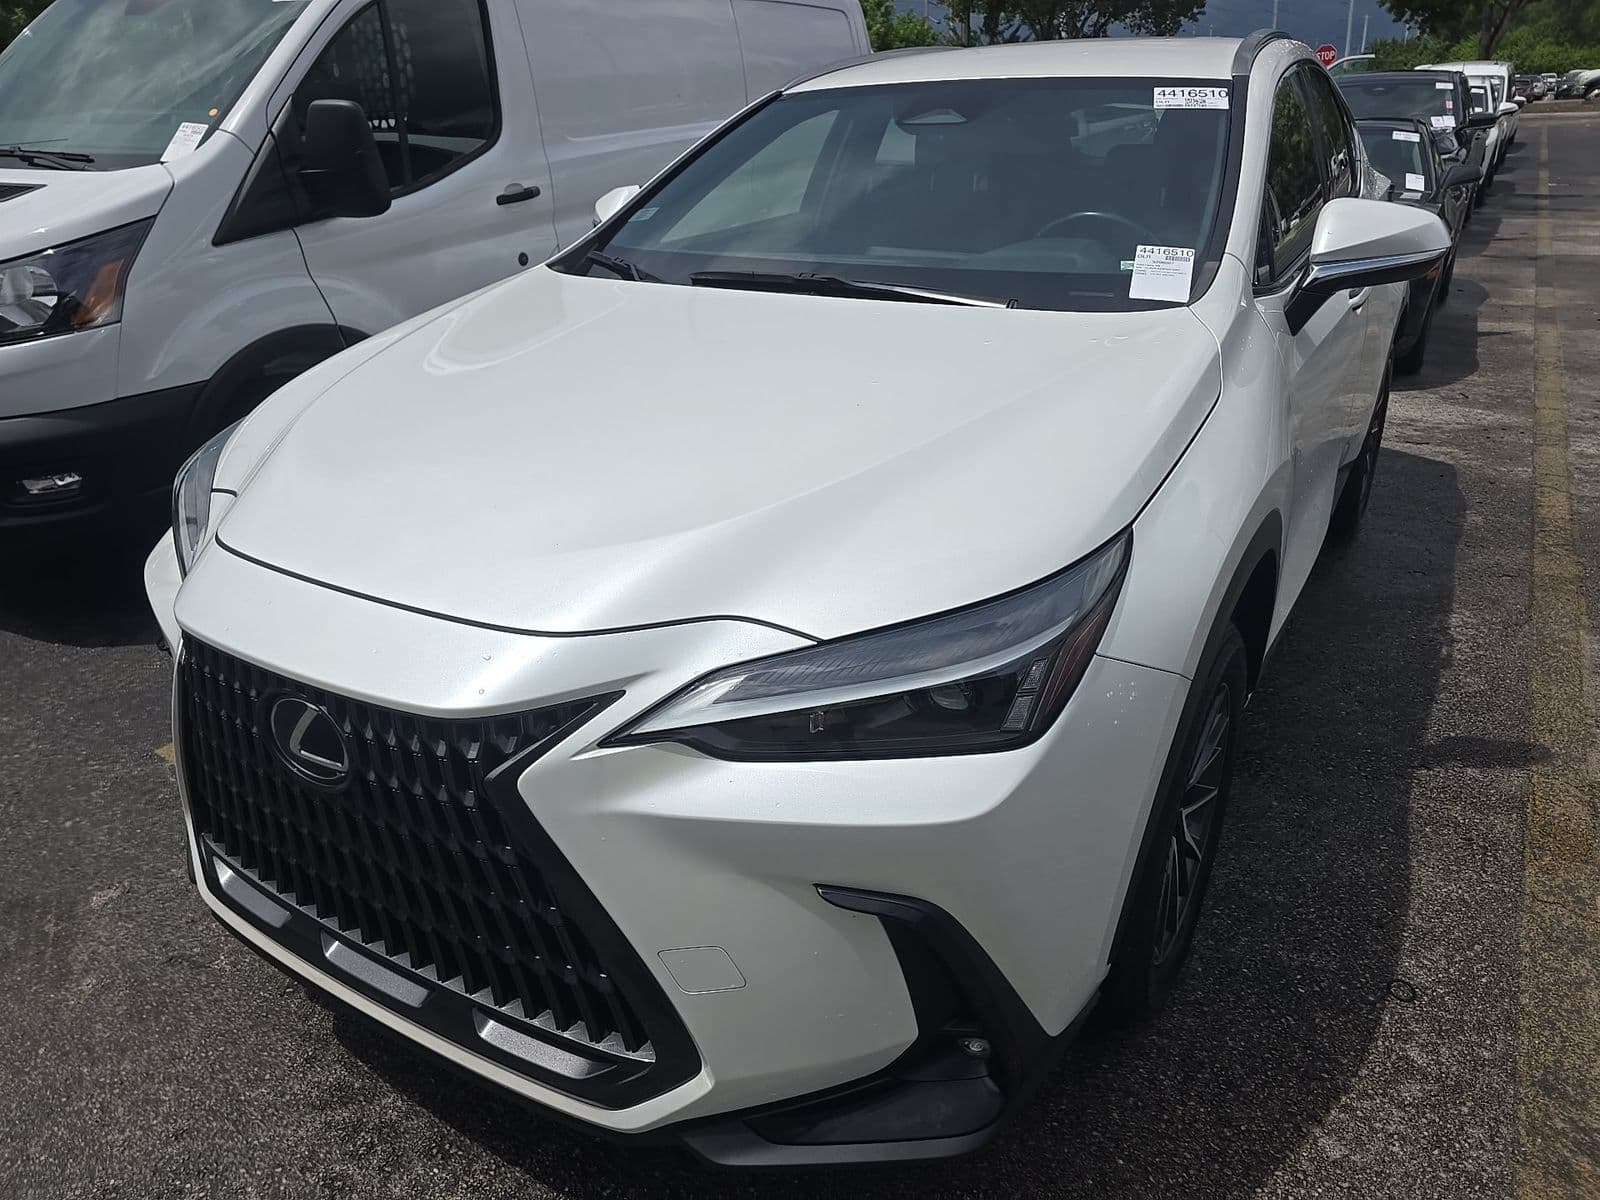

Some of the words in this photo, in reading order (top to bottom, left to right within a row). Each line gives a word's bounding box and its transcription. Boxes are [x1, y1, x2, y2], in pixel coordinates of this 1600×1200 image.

[1316, 51, 1335, 60] STOP
[1157, 89, 1228, 98] 4416510
[1139, 247, 1194, 257] 4416510
